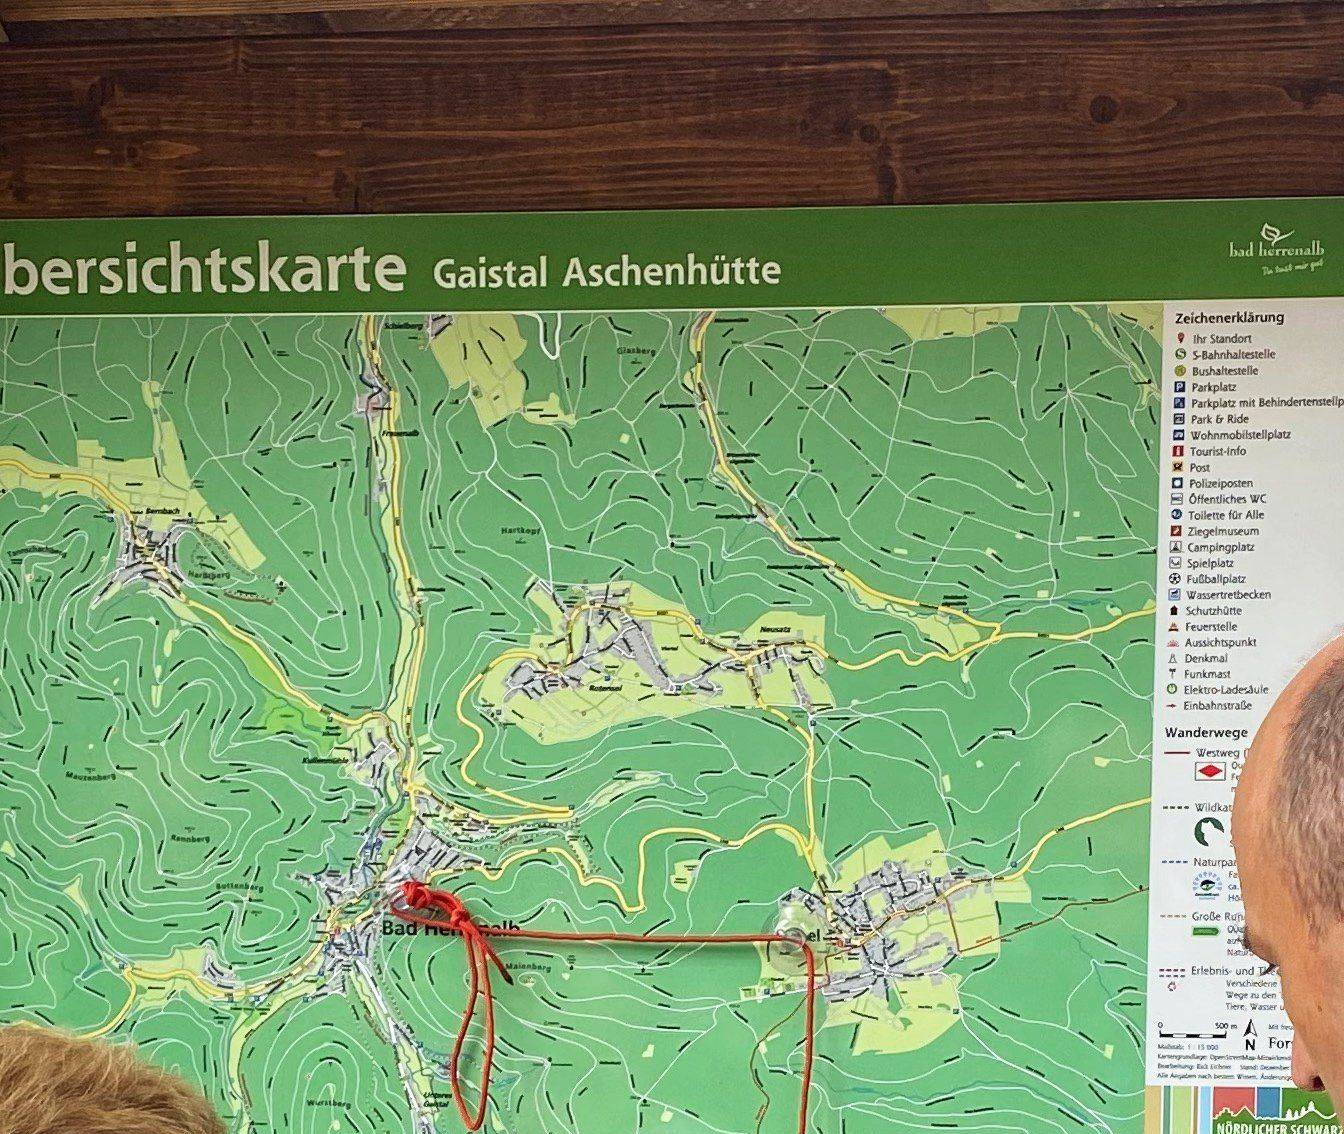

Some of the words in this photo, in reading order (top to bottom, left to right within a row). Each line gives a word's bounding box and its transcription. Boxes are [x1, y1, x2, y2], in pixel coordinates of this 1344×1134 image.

[1229, 242, 1254, 258] bad
[1258, 240, 1325, 257] herrenalb
[432, 255, 548, 290] Gaistal
[562, 252, 782, 288] Aschenhütte
[1175, 312, 1285, 326] Zeichenerklärung
[1193, 334, 1207, 344] Ihr
[1210, 333, 1252, 344] Standort
[1192, 350, 1276, 361] S-Bahnhaltestelle
[1192, 366, 1259, 377] Bushaltestelle
[1191, 382, 1237, 394] Parkplatz
[1191, 398, 1236, 410] Parkplatz
[1239, 397, 1256, 408] mit
[1191, 414, 1212, 425] Park
[1215, 414, 1224, 424] &
[1227, 414, 1249, 424] Ride
[1190, 429, 1291, 442] Wohnmobilstellplatz
[1190, 446, 1247, 457] Tourist-Info
[1189, 462, 1210, 473] Post
[1189, 478, 1253, 490] Polizeiposten
[1188, 493, 1247, 505] Öffentliches
[1249, 493, 1267, 504] WC
[1188, 510, 1226, 521] Toilette
[1228, 510, 1244, 520] für
[1245, 510, 1265, 520] Alle
[1187, 526, 1260, 538] Ziegelmuseum
[1187, 542, 1255, 554] Campingplatz
[1187, 558, 1234, 570] Spielplatz
[1186, 574, 1247, 586] Fußballplatz
[1186, 589, 1272, 601] Wassertretbecken
[1185, 605, 1243, 616] Schutzhütte
[1185, 621, 1238, 632] Feuerstelle
[1184, 637, 1257, 649] Aussichtspunkt
[1184, 653, 1228, 664] Denkmal
[1184, 669, 1231, 680] Funkmast
[1183, 684, 1269, 695] Elektro-Ladesäule
[1183, 700, 1253, 711] Einbahnstraße
[1164, 726, 1249, 741] Wanderwege
[1196, 748, 1240, 760] Westweg
[1192, 911, 1221, 921] Große
[382, 920, 417, 936] Bad
[1191, 966, 1232, 976] Erlebnis-
[1235, 966, 1255, 976] und
[1226, 991, 1248, 1001] Wege
[1261, 991, 1277, 1000] den
[1245, 1039, 1256, 1050] N
